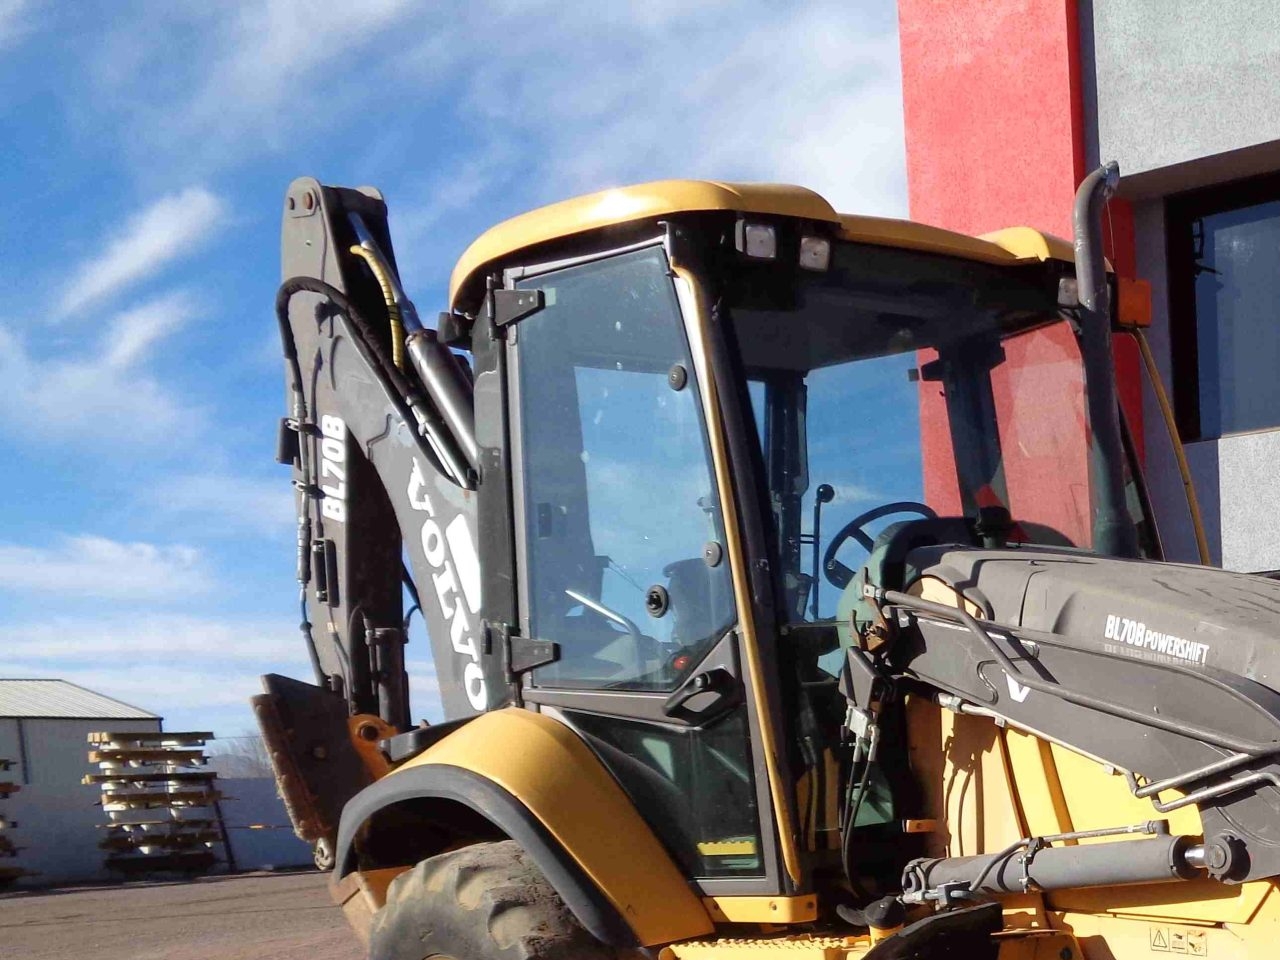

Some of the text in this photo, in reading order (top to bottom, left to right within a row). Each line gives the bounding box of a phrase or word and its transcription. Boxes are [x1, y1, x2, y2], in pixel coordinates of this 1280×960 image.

[321, 413, 345, 523] BL70B
[407, 456, 488, 712] VOLVO
[1104, 614, 1210, 664] BL70B POWERSHIFT
